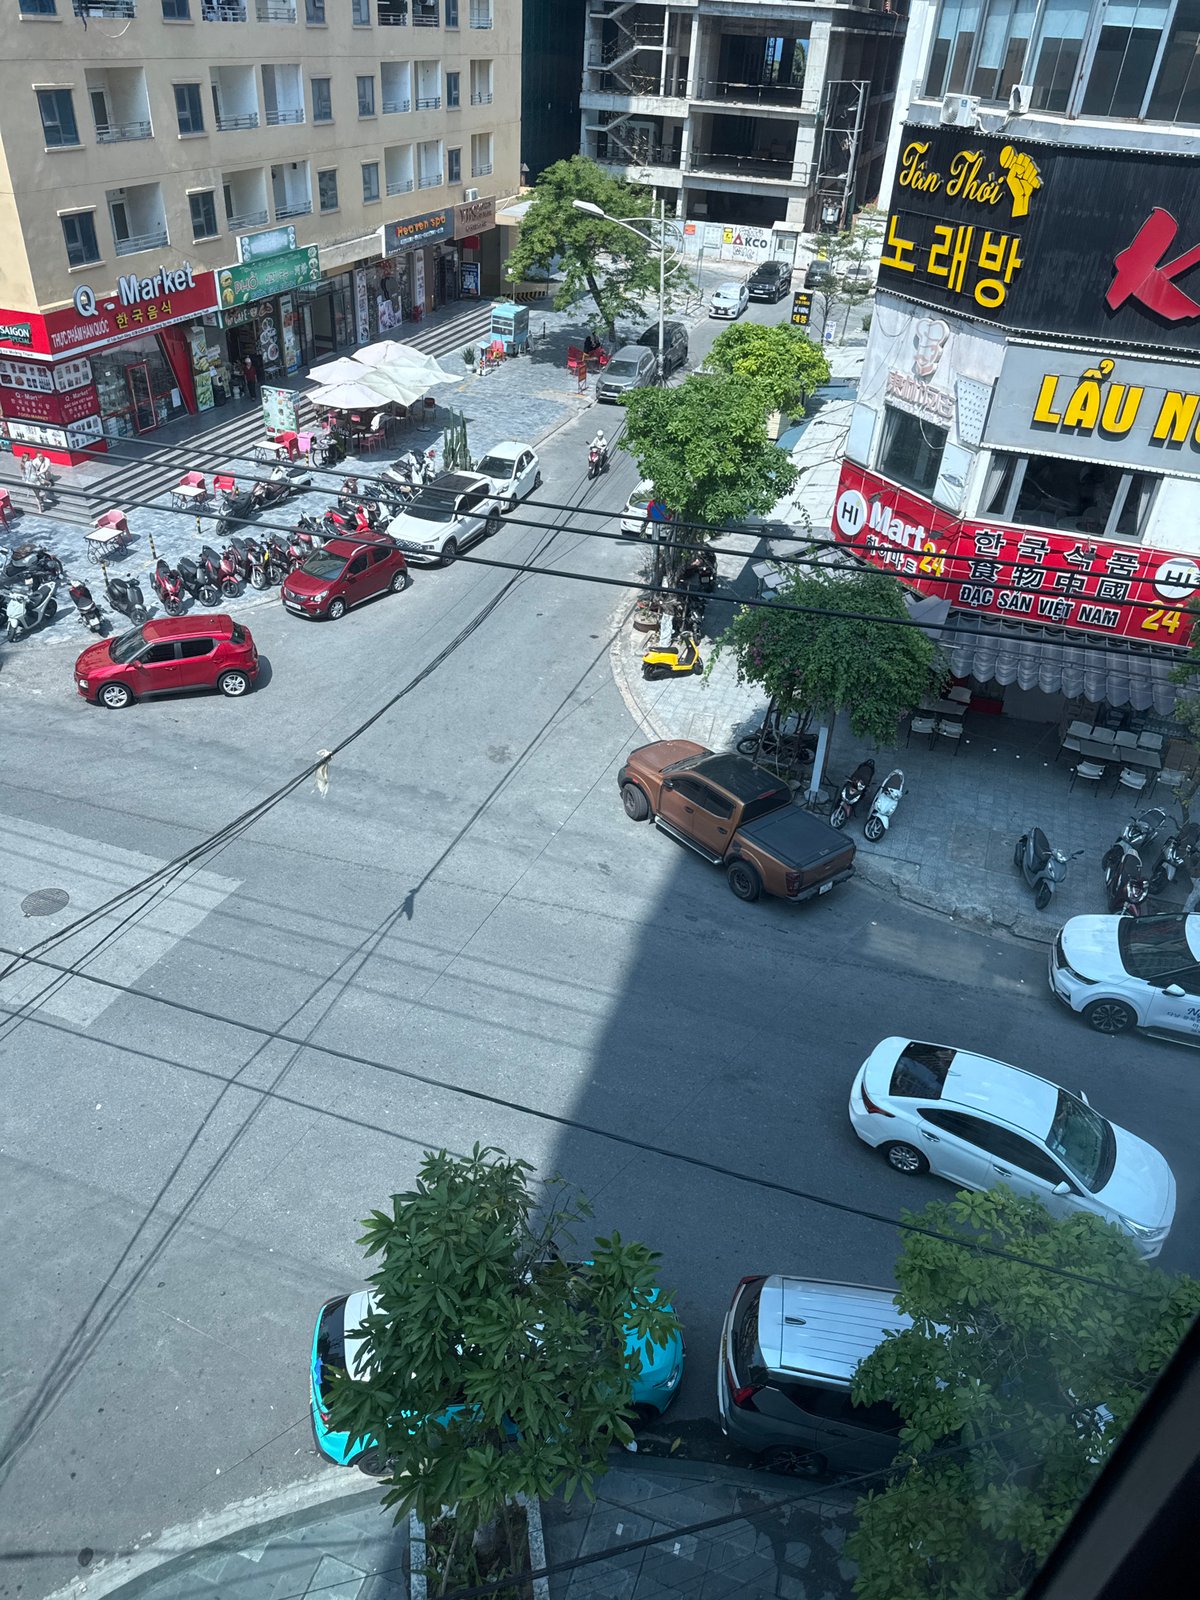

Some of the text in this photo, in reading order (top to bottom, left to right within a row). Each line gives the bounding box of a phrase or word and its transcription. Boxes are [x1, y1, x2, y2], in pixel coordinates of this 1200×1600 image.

[900, 141, 1007, 205] Tân Thời
[396, 220, 429, 237] Heaven
[880, 214, 1024, 308] 노래방
[73, 285, 98, 317] Q
[117, 260, 196, 306] Market
[0, 324, 30, 337] SAIGON
[115, 299, 172, 329] 한국음식
[1034, 358, 1200, 443] LẨU N
[869, 501, 925, 551] Mart
[919, 542, 946, 577] 24
[973, 529, 1139, 577] 한국식품
[959, 585, 1121, 628] ĐẶC SẢN VIỆT NAM
[1141, 600, 1183, 634] 24
